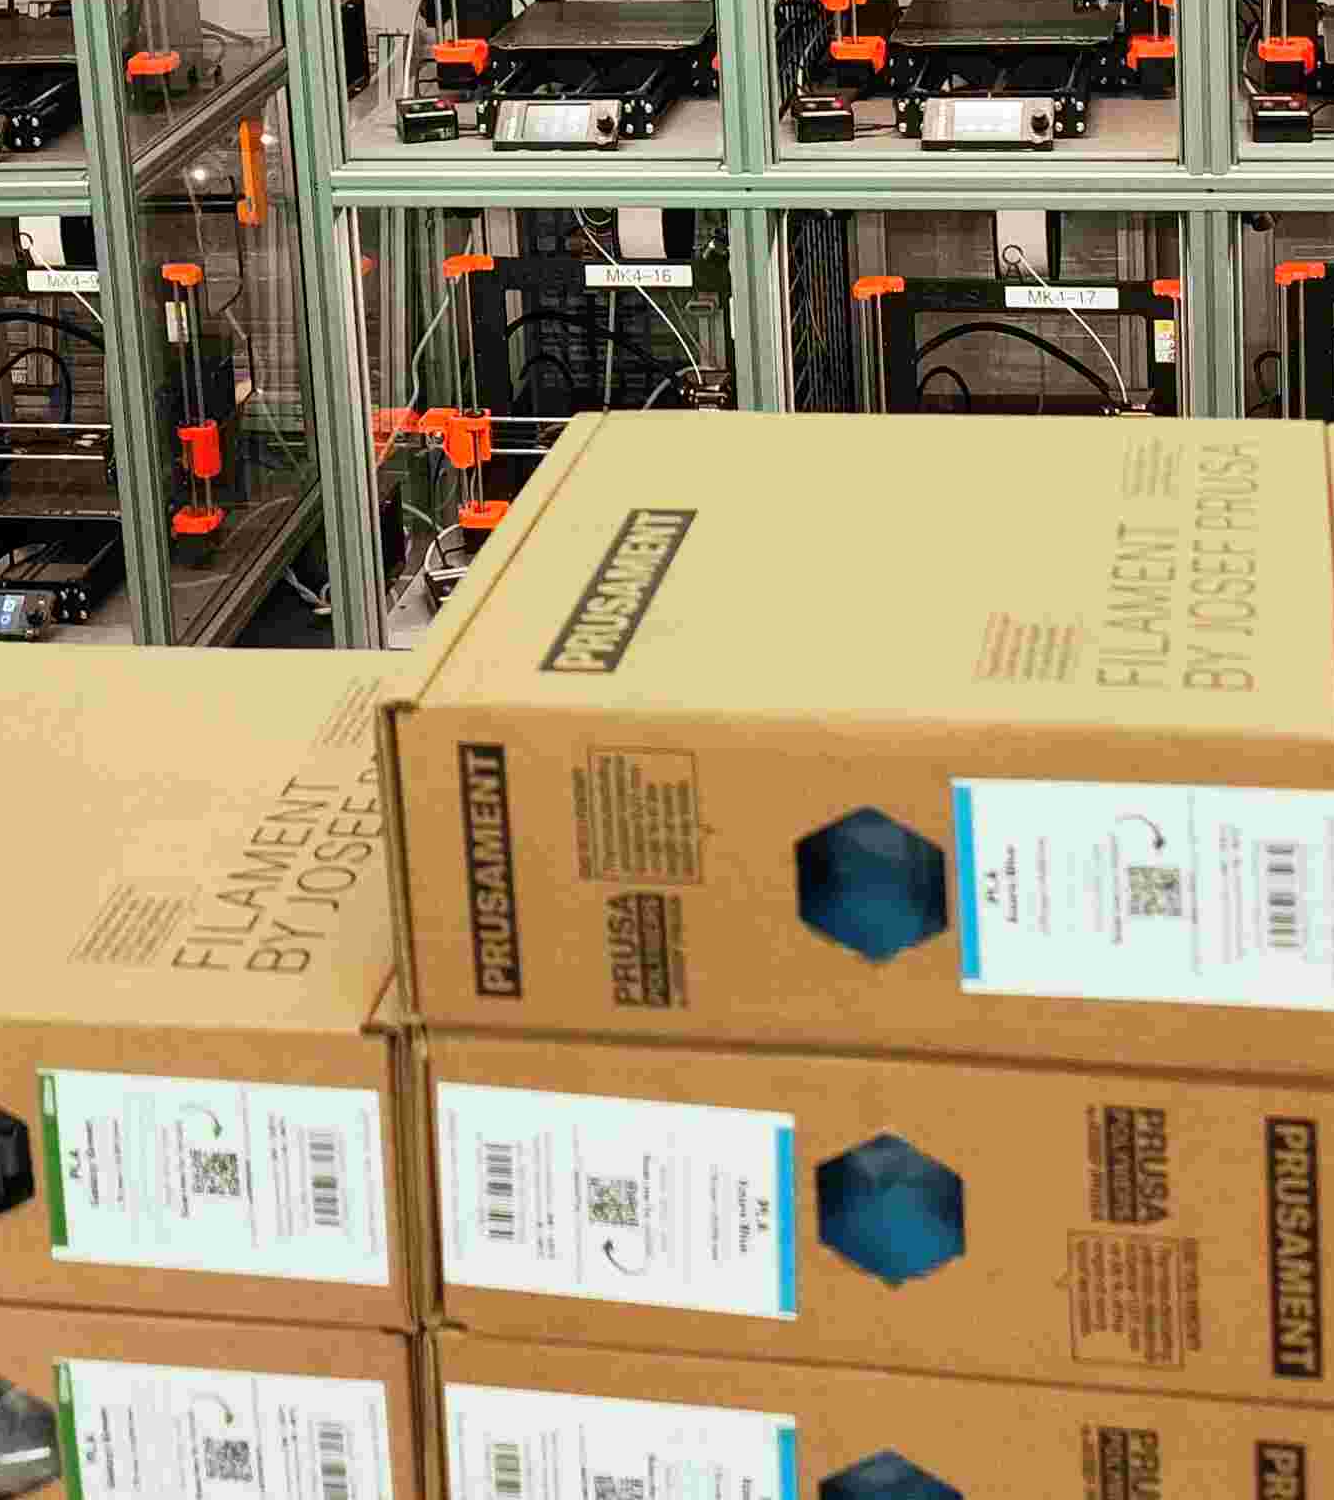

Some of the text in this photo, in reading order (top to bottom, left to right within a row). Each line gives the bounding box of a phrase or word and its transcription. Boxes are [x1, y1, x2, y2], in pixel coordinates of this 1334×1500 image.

[605, 266, 673, 286] MK4-16
[552, 512, 685, 670] PRUSAMENT
[1096, 520, 1180, 693] FILAMENT
[1185, 538, 1259, 638] JOSEF
[1180, 642, 1259, 693] BY
[170, 774, 341, 972] FILAMENT
[467, 749, 517, 995] PRUSAMENT
[244, 918, 327, 974] BY
[605, 898, 643, 1007] PRUSA
[1134, 1109, 1170, 1225] PRUSA
[1271, 1120, 1318, 1374] PRUSAMENT
